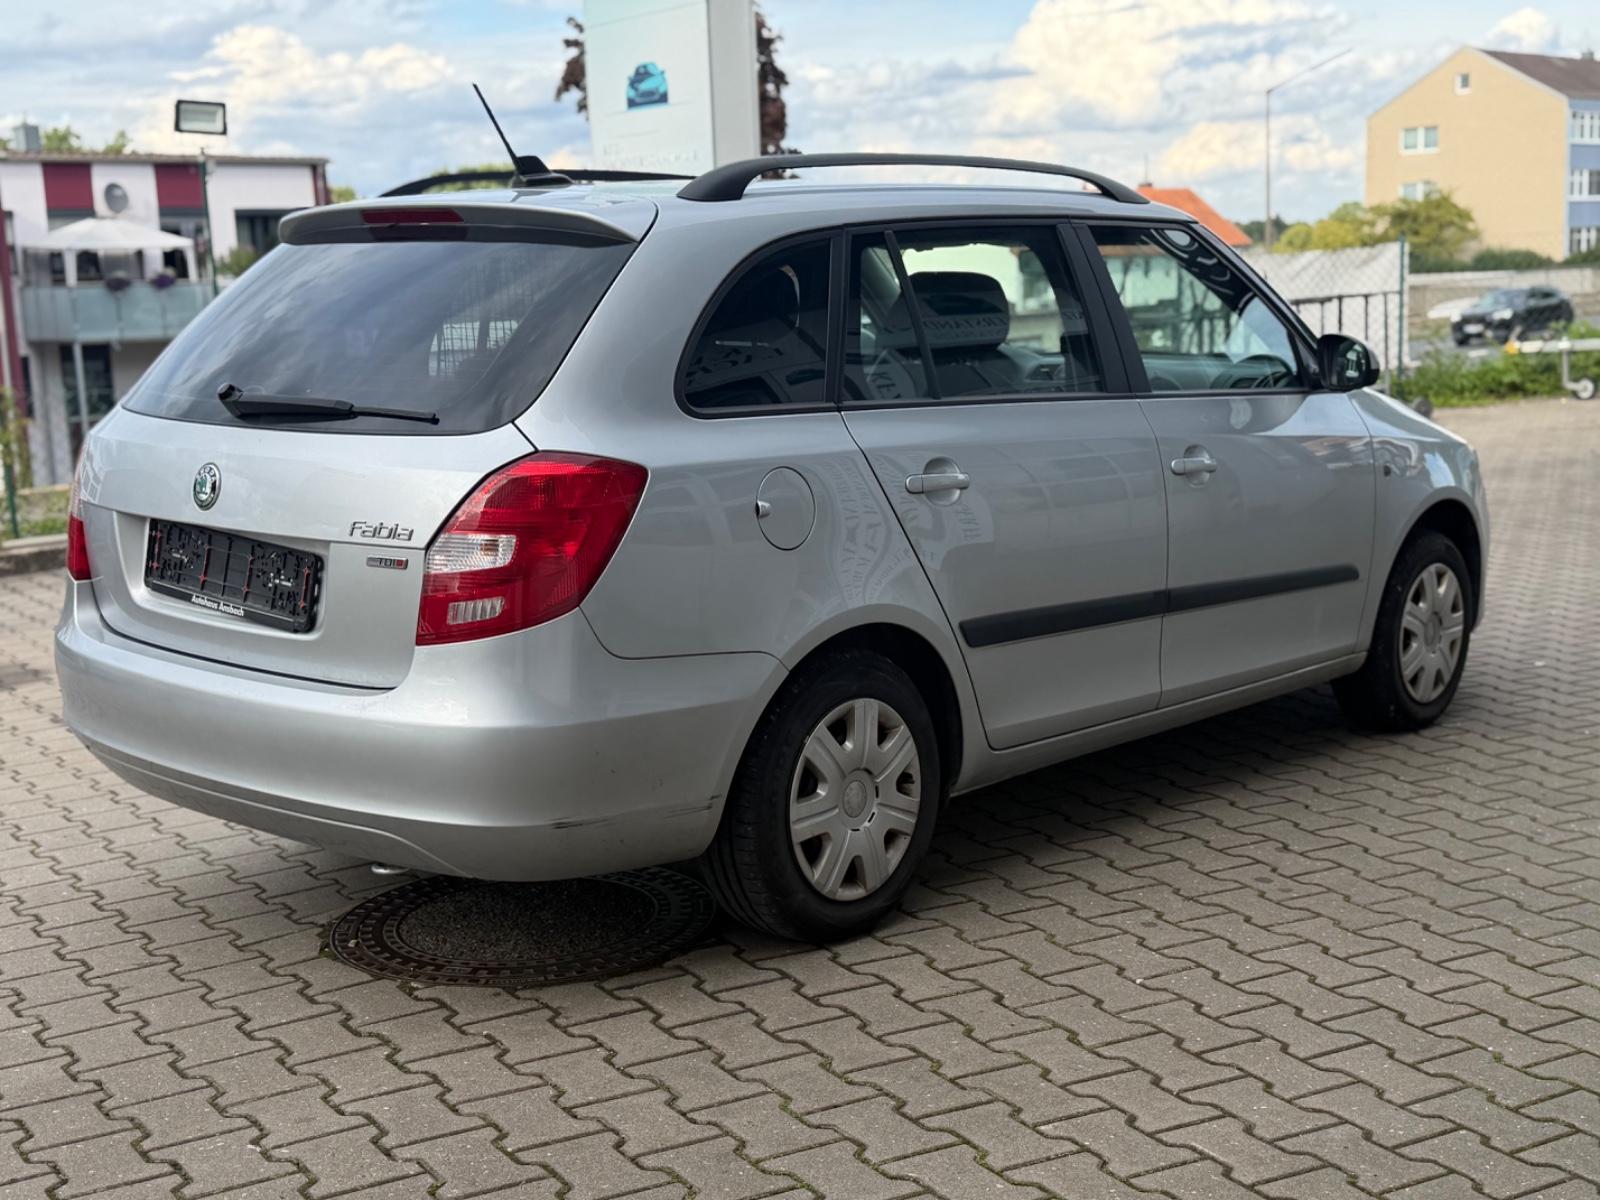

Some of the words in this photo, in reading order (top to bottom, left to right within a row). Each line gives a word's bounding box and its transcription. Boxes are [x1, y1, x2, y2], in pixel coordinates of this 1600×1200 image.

[349, 521, 414, 541] Fabia
[191, 593, 219, 609] Autohaus
[219, 601, 244, 617] Ansbach
